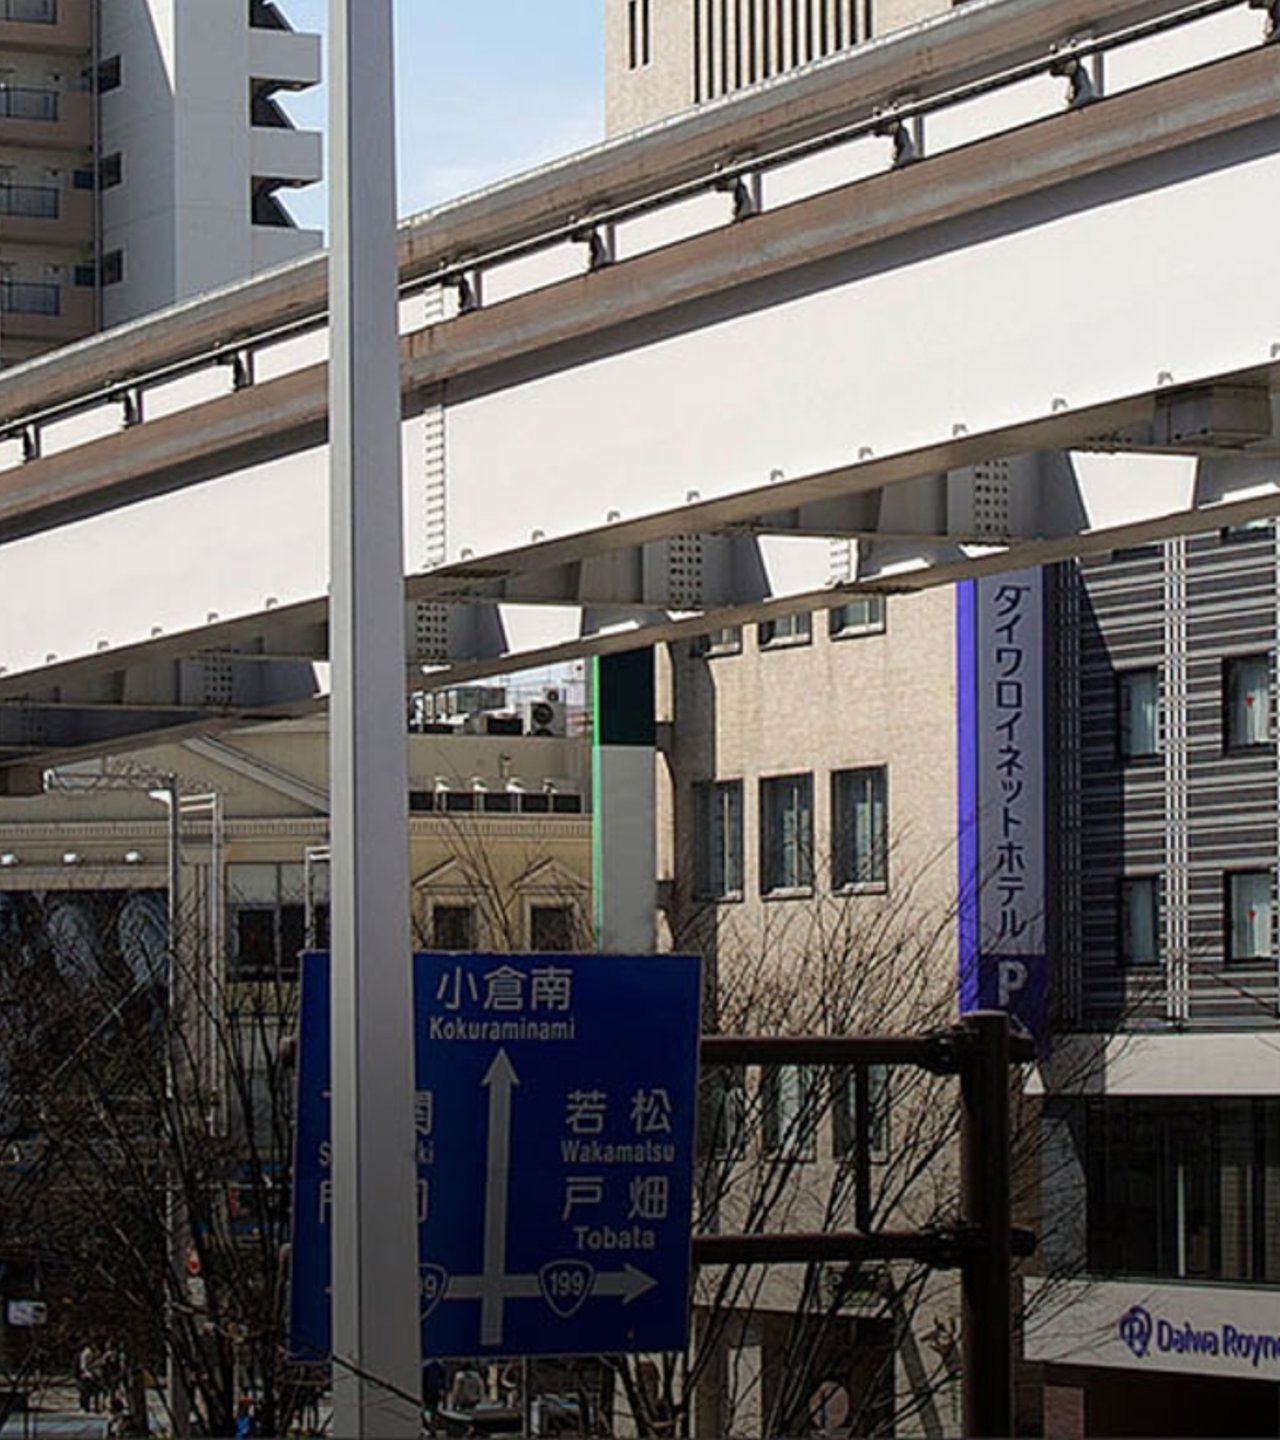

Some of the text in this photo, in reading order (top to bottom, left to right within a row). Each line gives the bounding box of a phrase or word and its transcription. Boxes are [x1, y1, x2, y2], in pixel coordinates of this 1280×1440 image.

[992, 584, 1030, 938] ダイワロイネットホテル
[435, 964, 573, 1010] 小倉南
[429, 1016, 575, 1040] Kokuraminami
[564, 1089, 673, 1135] 若松
[560, 1140, 675, 1164] Wakamatsu
[561, 1176, 669, 1221] 戸畑
[574, 1226, 656, 1250] Tobata
[549, 1270, 583, 1297] 199
[1156, 1319, 1219, 1357] Daiwa
